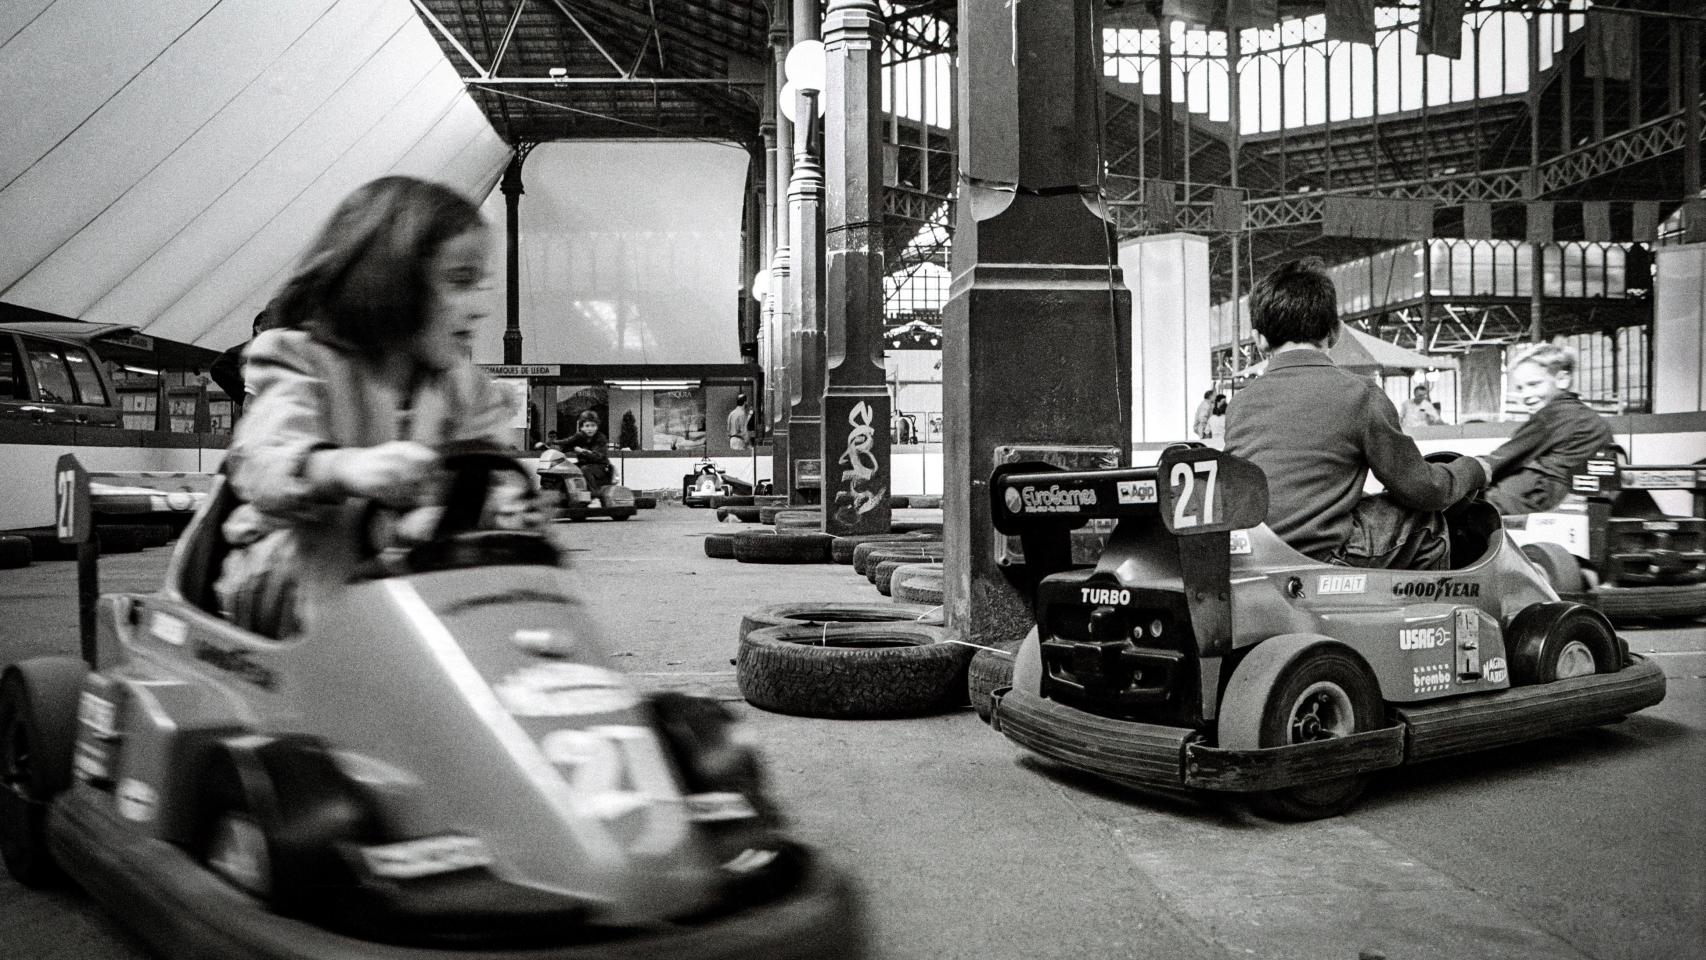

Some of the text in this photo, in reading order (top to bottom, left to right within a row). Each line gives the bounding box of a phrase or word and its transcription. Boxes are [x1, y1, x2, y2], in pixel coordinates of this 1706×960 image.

[521, 366, 528, 375] DE
[1021, 484, 1097, 507] EuroGames
[1130, 484, 1154, 501] Agip
[1171, 460, 1218, 529] 27
[1319, 576, 1365, 594] FIAT
[1081, 588, 1130, 605] TURBO
[1400, 629, 1436, 650] USAG
[1413, 671, 1450, 687] brembo
